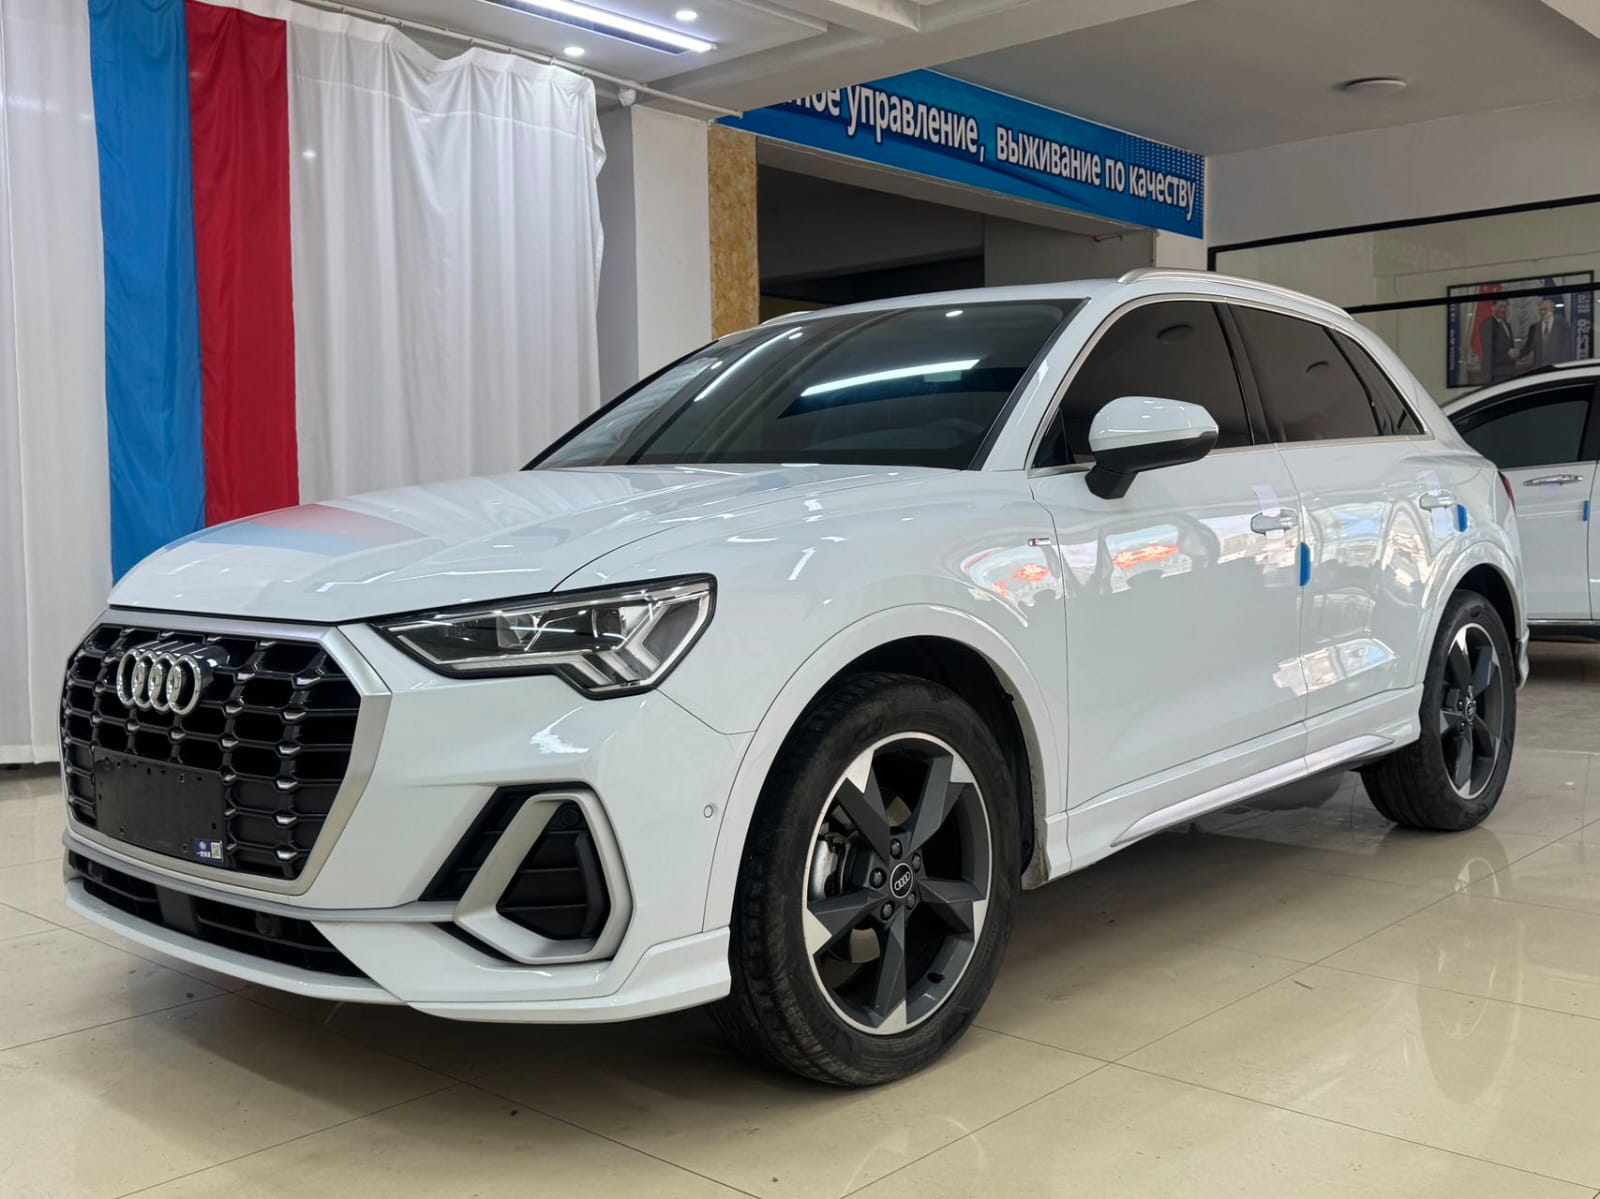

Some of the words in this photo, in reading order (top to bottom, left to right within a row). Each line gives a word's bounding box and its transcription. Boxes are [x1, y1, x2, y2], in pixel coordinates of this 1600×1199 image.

[847, 86, 984, 162] управление,
[996, 126, 1101, 186] выживание
[1105, 158, 1125, 192] по
[1129, 165, 1195, 221] качеству
